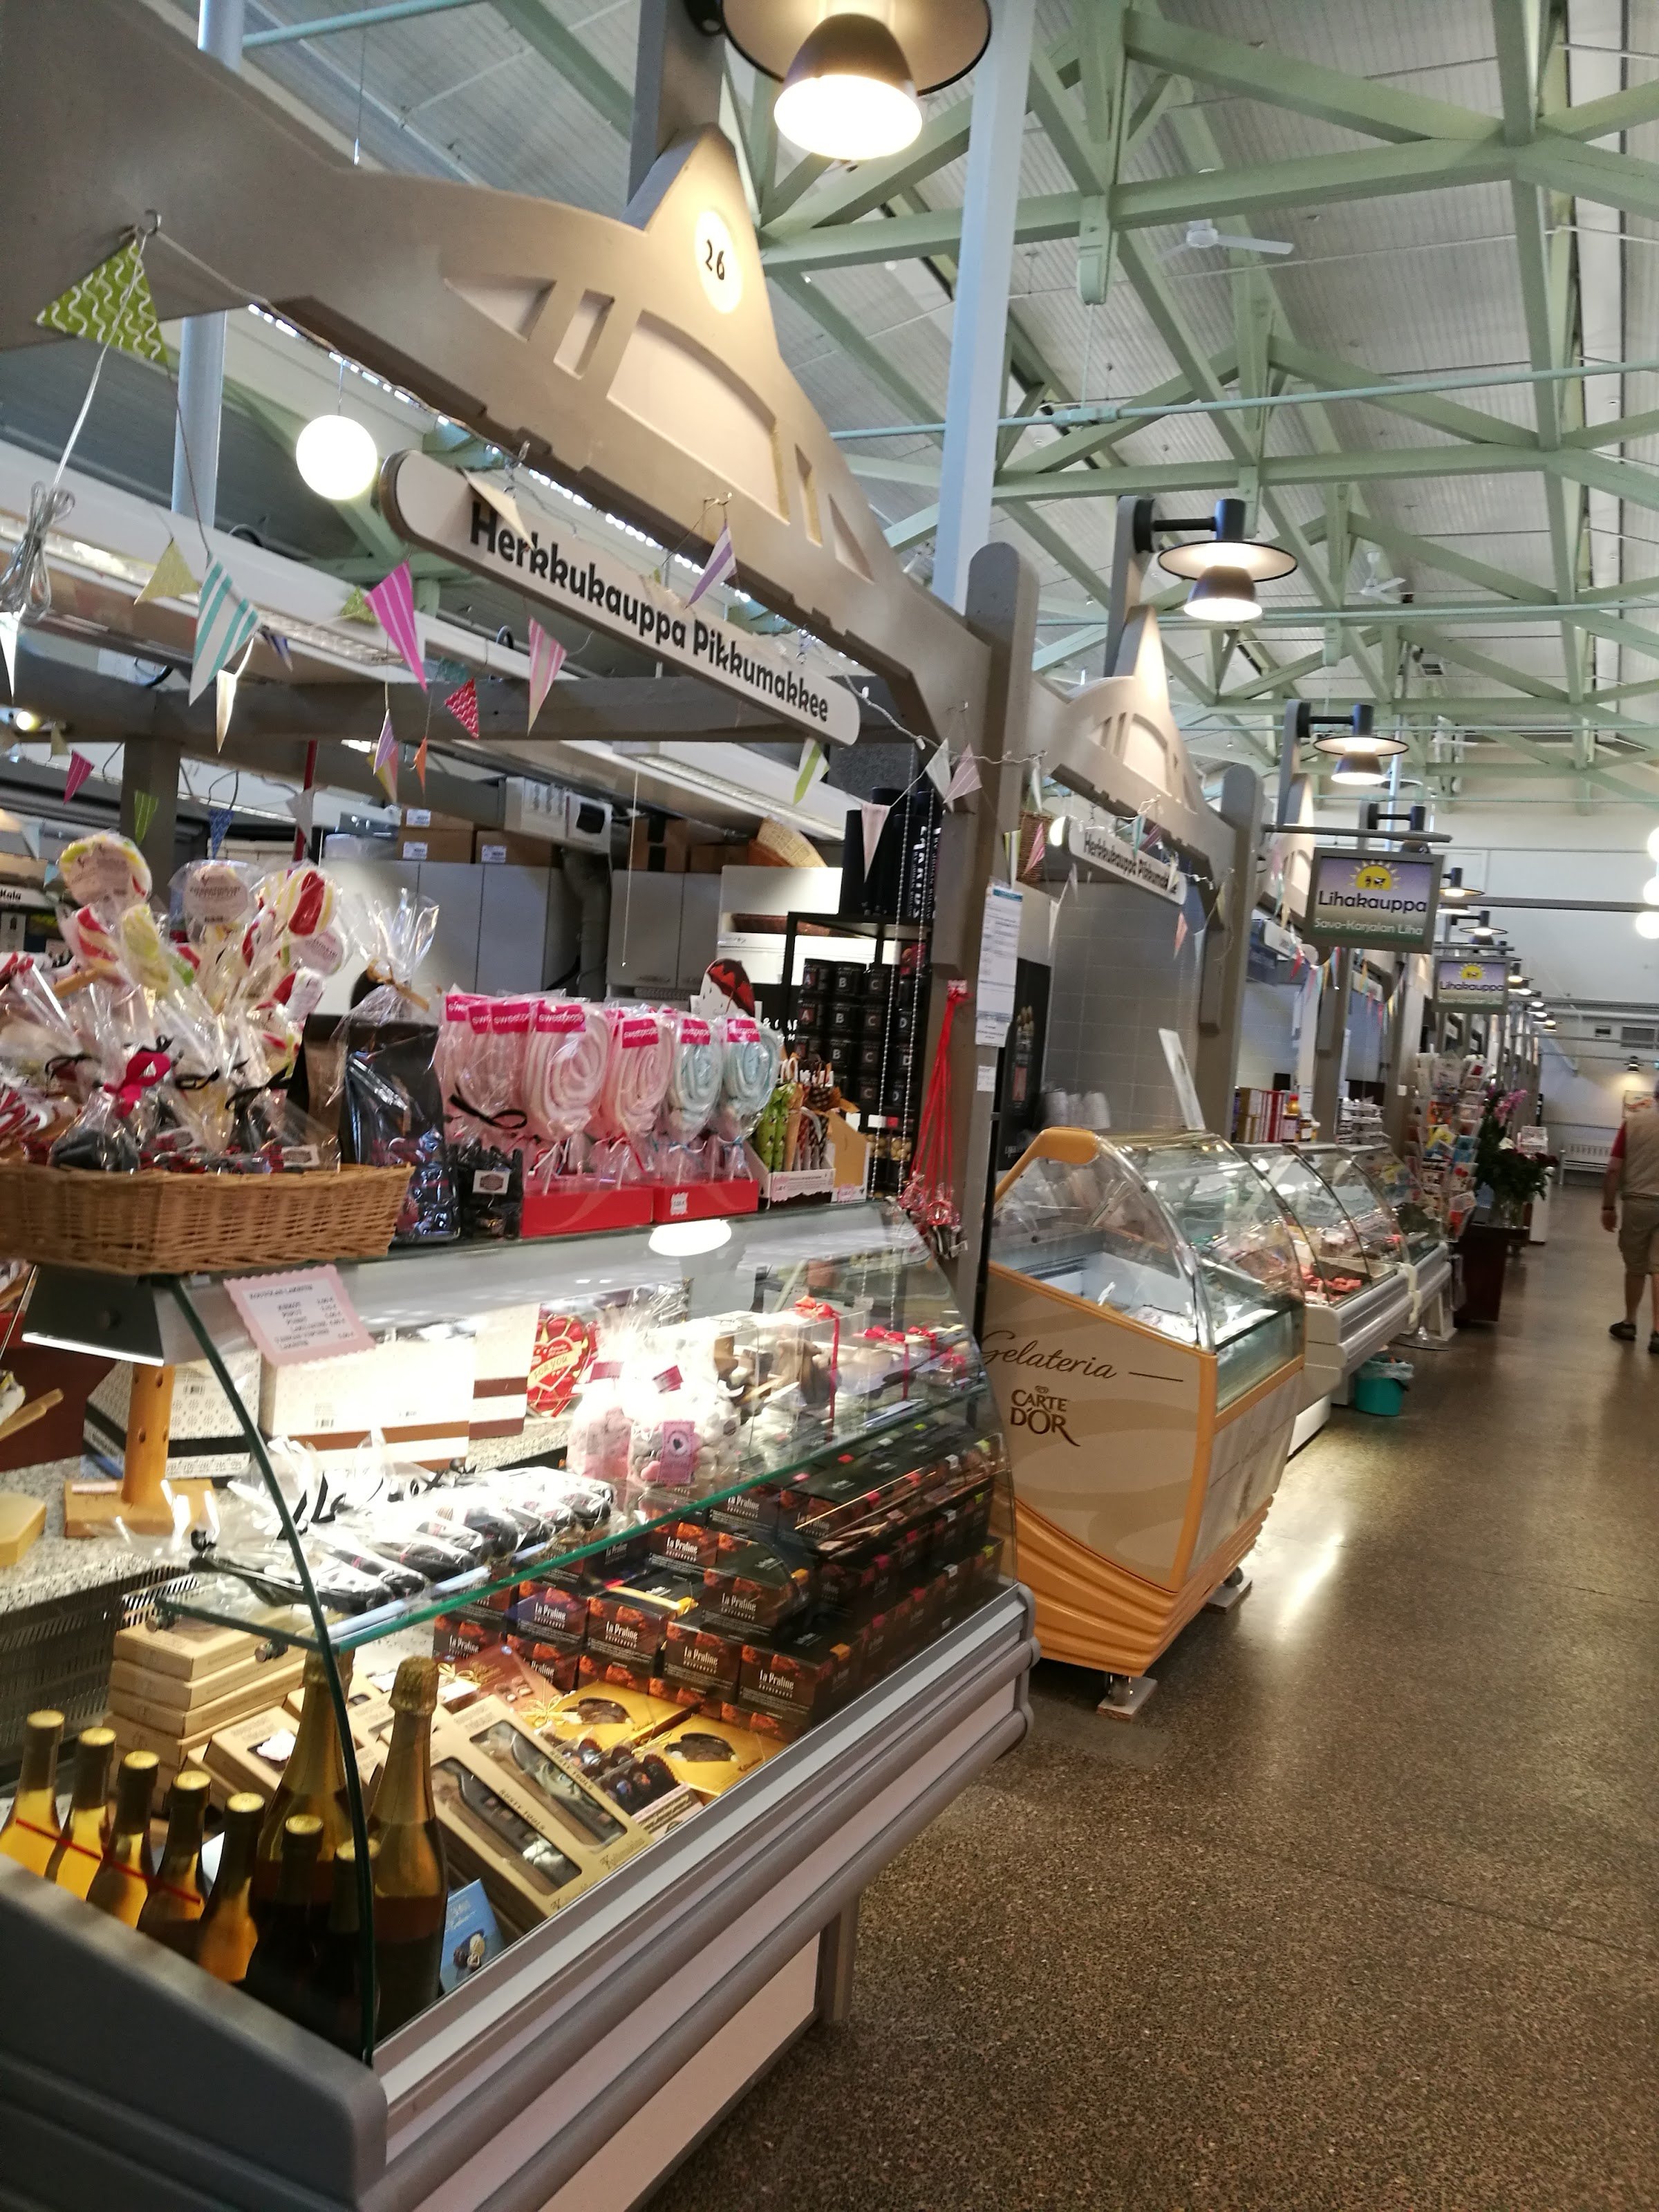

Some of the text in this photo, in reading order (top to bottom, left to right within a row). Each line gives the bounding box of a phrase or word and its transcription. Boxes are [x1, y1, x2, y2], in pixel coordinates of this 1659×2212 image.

[705, 239, 724, 281] 26
[470, 500, 828, 722] Herkkukauppa Pikkumakkee
[1318, 890, 1427, 914] Lihakauppa
[1315, 917, 1423, 935] Savo-Karjalan Liha
[838, 977, 847, 988] B
[870, 980, 880, 990] C
[836, 1013, 845, 1024] B
[868, 1015, 877, 1027] C
[832, 1049, 841, 1060] B
[865, 1051, 874, 1062] C
[982, 1330, 1117, 1378] Gelateria
[1011, 1389, 1068, 1412] CARTE
[1010, 1406, 1081, 1447] D'OR
[737, 1494, 760, 1511] Praline
[666, 1536, 698, 1555] La Praline
[535, 1601, 567, 1622] La Praline
[720, 1592, 757, 1612] La Praline
[606, 1620, 615, 1633] La
[615, 1622, 638, 1641] Praline
[458, 1637, 480, 1654] Praline
[684, 1645, 719, 1667] La Praline
[759, 1668, 795, 1690] La Praline
